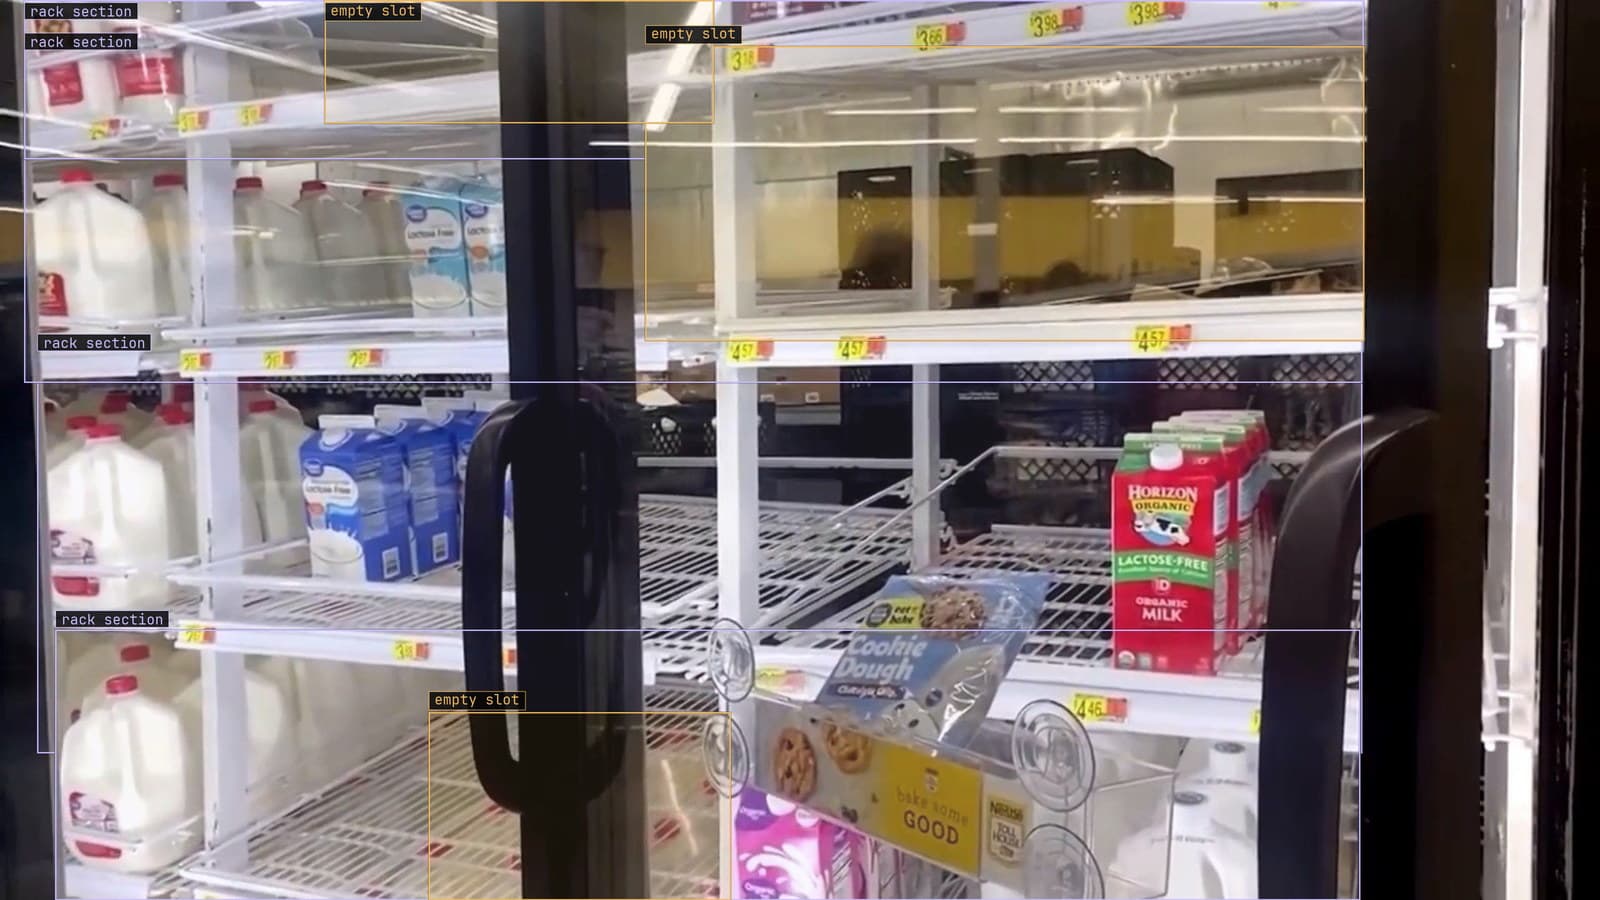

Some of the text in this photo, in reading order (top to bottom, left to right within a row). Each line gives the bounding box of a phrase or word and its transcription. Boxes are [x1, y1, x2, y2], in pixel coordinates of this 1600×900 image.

[1128, 484, 1198, 503] HORIZON
[1134, 500, 1191, 513] ORGANIC
[1118, 554, 1209, 572] LACTOSE-FREE
[1135, 596, 1189, 609] ORGANIC
[1142, 607, 1183, 623] MILK
[851, 634, 928, 658] Cookie
[834, 657, 914, 684] Dough
[896, 785, 928, 809] bake
[904, 809, 959, 845] GOOD
